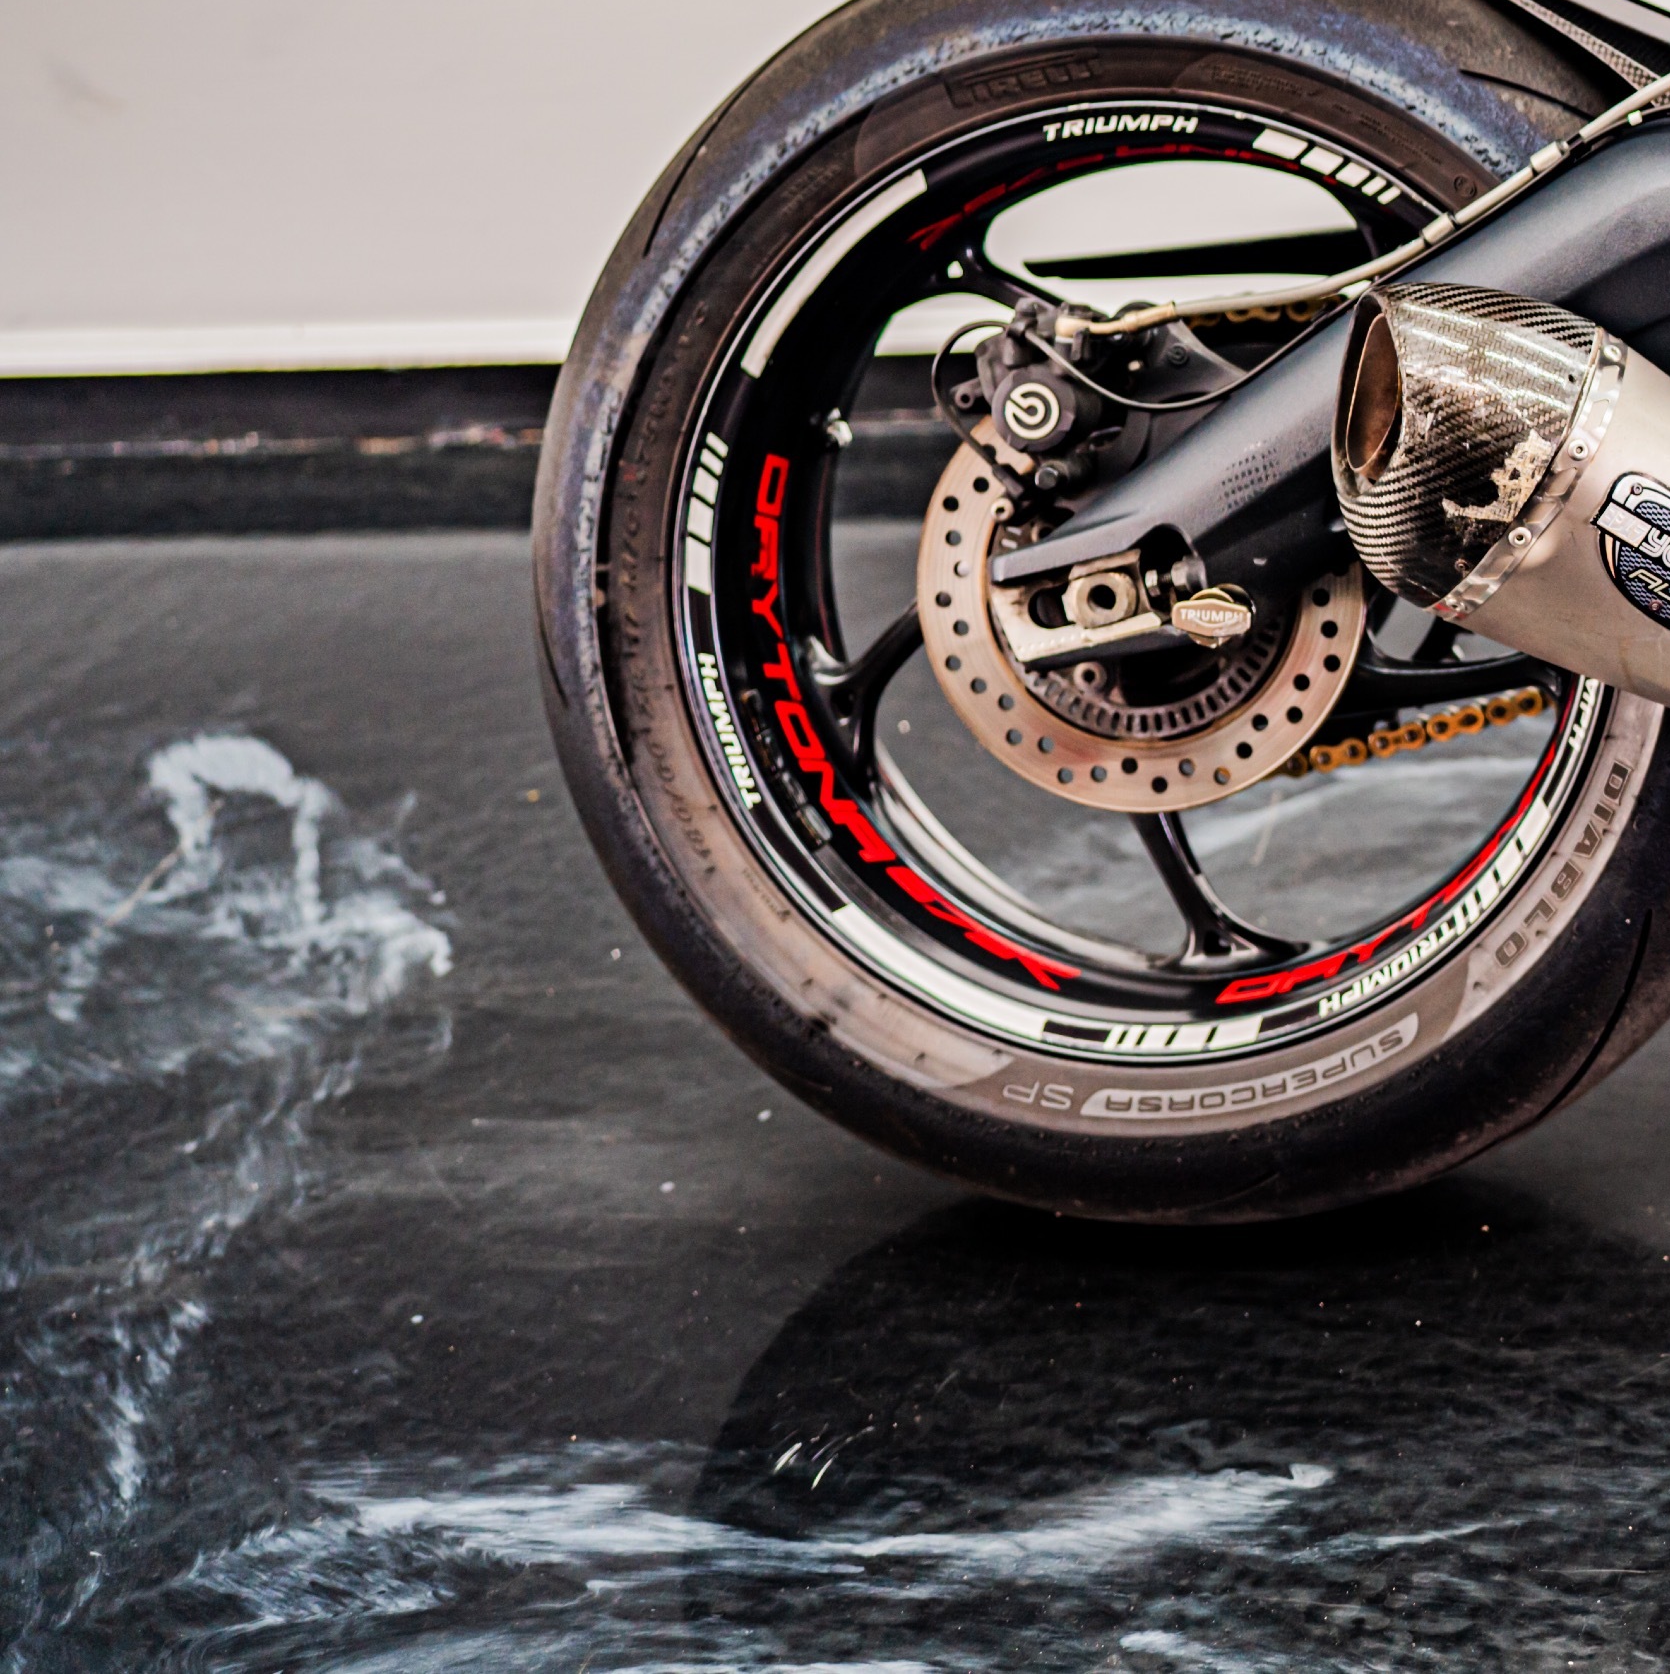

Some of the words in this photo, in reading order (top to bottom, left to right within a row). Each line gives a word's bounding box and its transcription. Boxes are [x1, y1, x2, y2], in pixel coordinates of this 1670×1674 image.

[1042, 113, 1199, 142] TRIUMPH
[1180, 608, 1244, 623] TRIUMPH
[698, 652, 761, 809] TRIUMPH
[1495, 760, 1634, 969] DIABLO
[1314, 917, 1462, 1020] TRIUMPH
[1003, 1080, 1076, 1111] SP
[1104, 1030, 1405, 1113] SUPERCORSA
